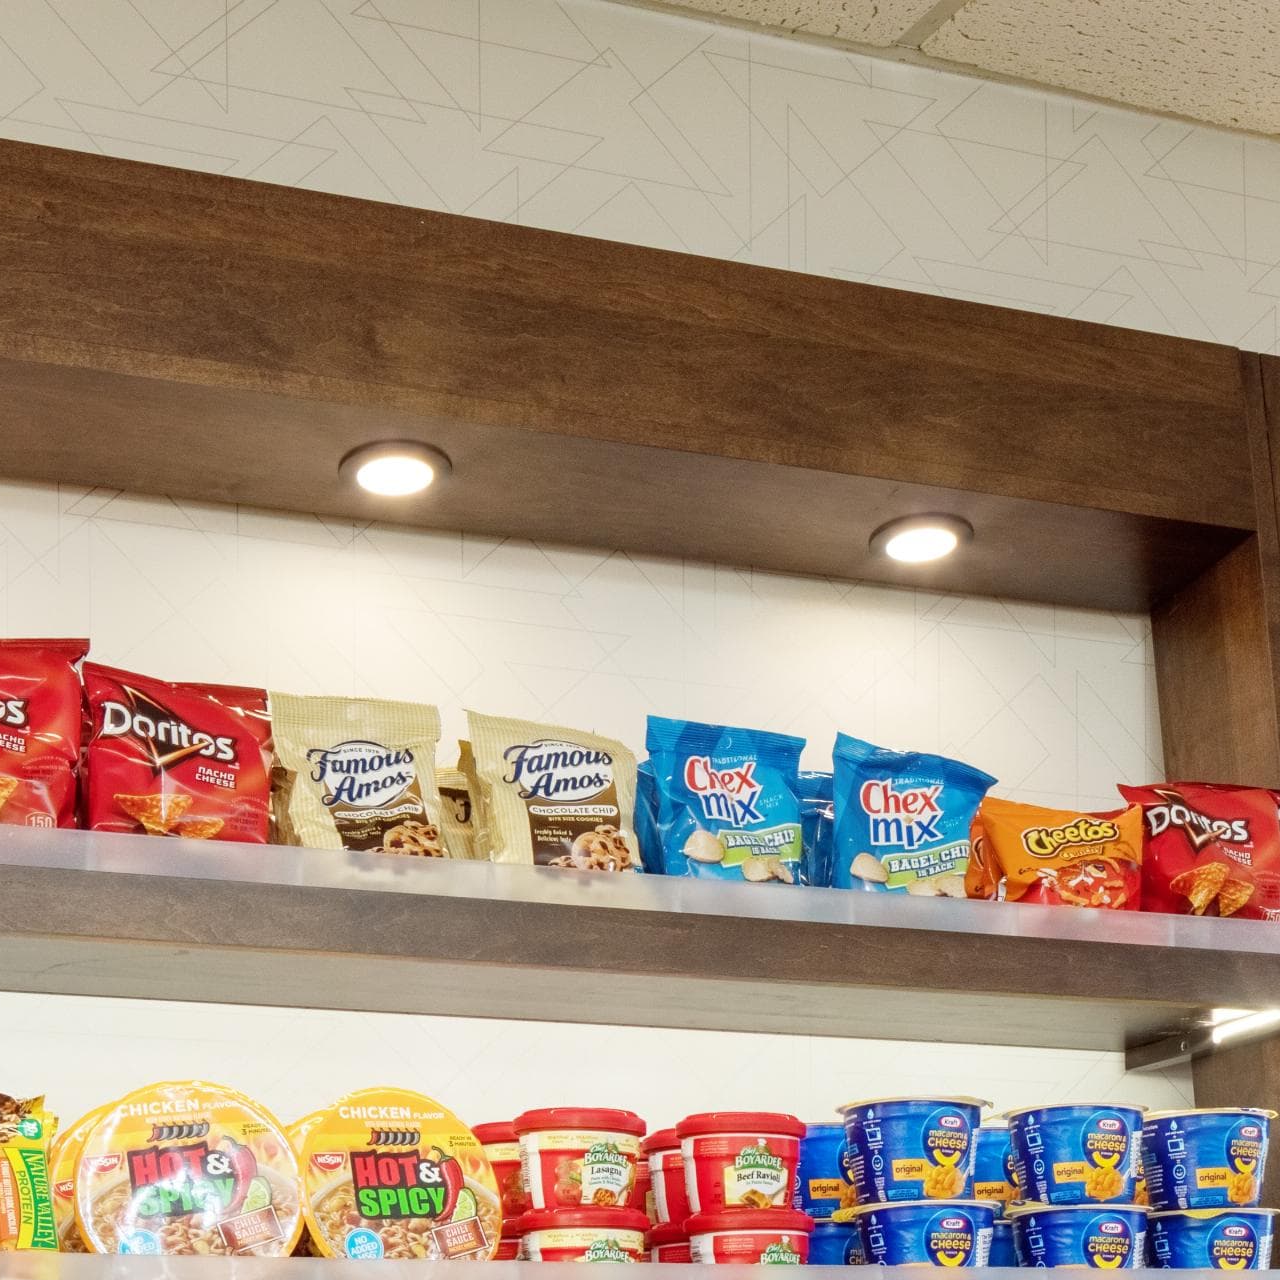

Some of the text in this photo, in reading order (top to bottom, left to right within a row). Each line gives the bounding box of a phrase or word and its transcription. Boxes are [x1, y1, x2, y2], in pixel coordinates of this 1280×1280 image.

[103, 701, 235, 761] Doritos
[306, 747, 415, 783] Famous
[503, 743, 613, 784] Famous
[195, 773, 236, 789] CHEESE
[685, 757, 758, 795] Chex
[321, 771, 413, 807] Amos
[518, 772, 611, 800] Amos
[861, 781, 941, 815] Chex
[531, 806, 616, 815] CHOCOLATE CHIP
[1147, 804, 1249, 841] Doritos
[726, 829, 796, 848] BAGEL CHIP
[1024, 818, 1117, 857] Cheetos
[889, 853, 939, 873] BAGEL
[119, 1099, 200, 1118] CHICKEN
[339, 1106, 445, 1120] CHICKEN FLAVOR
[943, 1117, 959, 1126] Kraft
[1102, 1120, 1118, 1129] Kraft
[928, 1129, 962, 1139] macaroni
[1087, 1132, 1122, 1141] macaroni
[131, 1147, 233, 1187] HOT &
[734, 1155, 783, 1170] BOYARDEE
[354, 1154, 443, 1188] HOT &
[736, 1171, 754, 1182] Beef
[756, 1170, 781, 1183] Ravioli
[895, 1164, 923, 1177] original
[1056, 1166, 1085, 1179] original
[1199, 1173, 1227, 1184] original
[811, 1182, 840, 1195] original
[976, 1186, 1004, 1199] original
[16, 1170, 33, 1225] PROTEIN
[22, 1150, 56, 1246] NATURE VALLEY
[137, 1177, 236, 1217] SPICY
[358, 1186, 446, 1217] SPICY
[445, 1225, 470, 1237] CHILI
[945, 1219, 960, 1228] Kraft
[1103, 1223, 1119, 1233] Kraft
[931, 1231, 966, 1240] macaroni
[1227, 1227, 1243, 1236] Kraft
[445, 1232, 475, 1248] SAUCE
[1088, 1235, 1124, 1244] macaroni
[1213, 1239, 1249, 1248] macaroni
